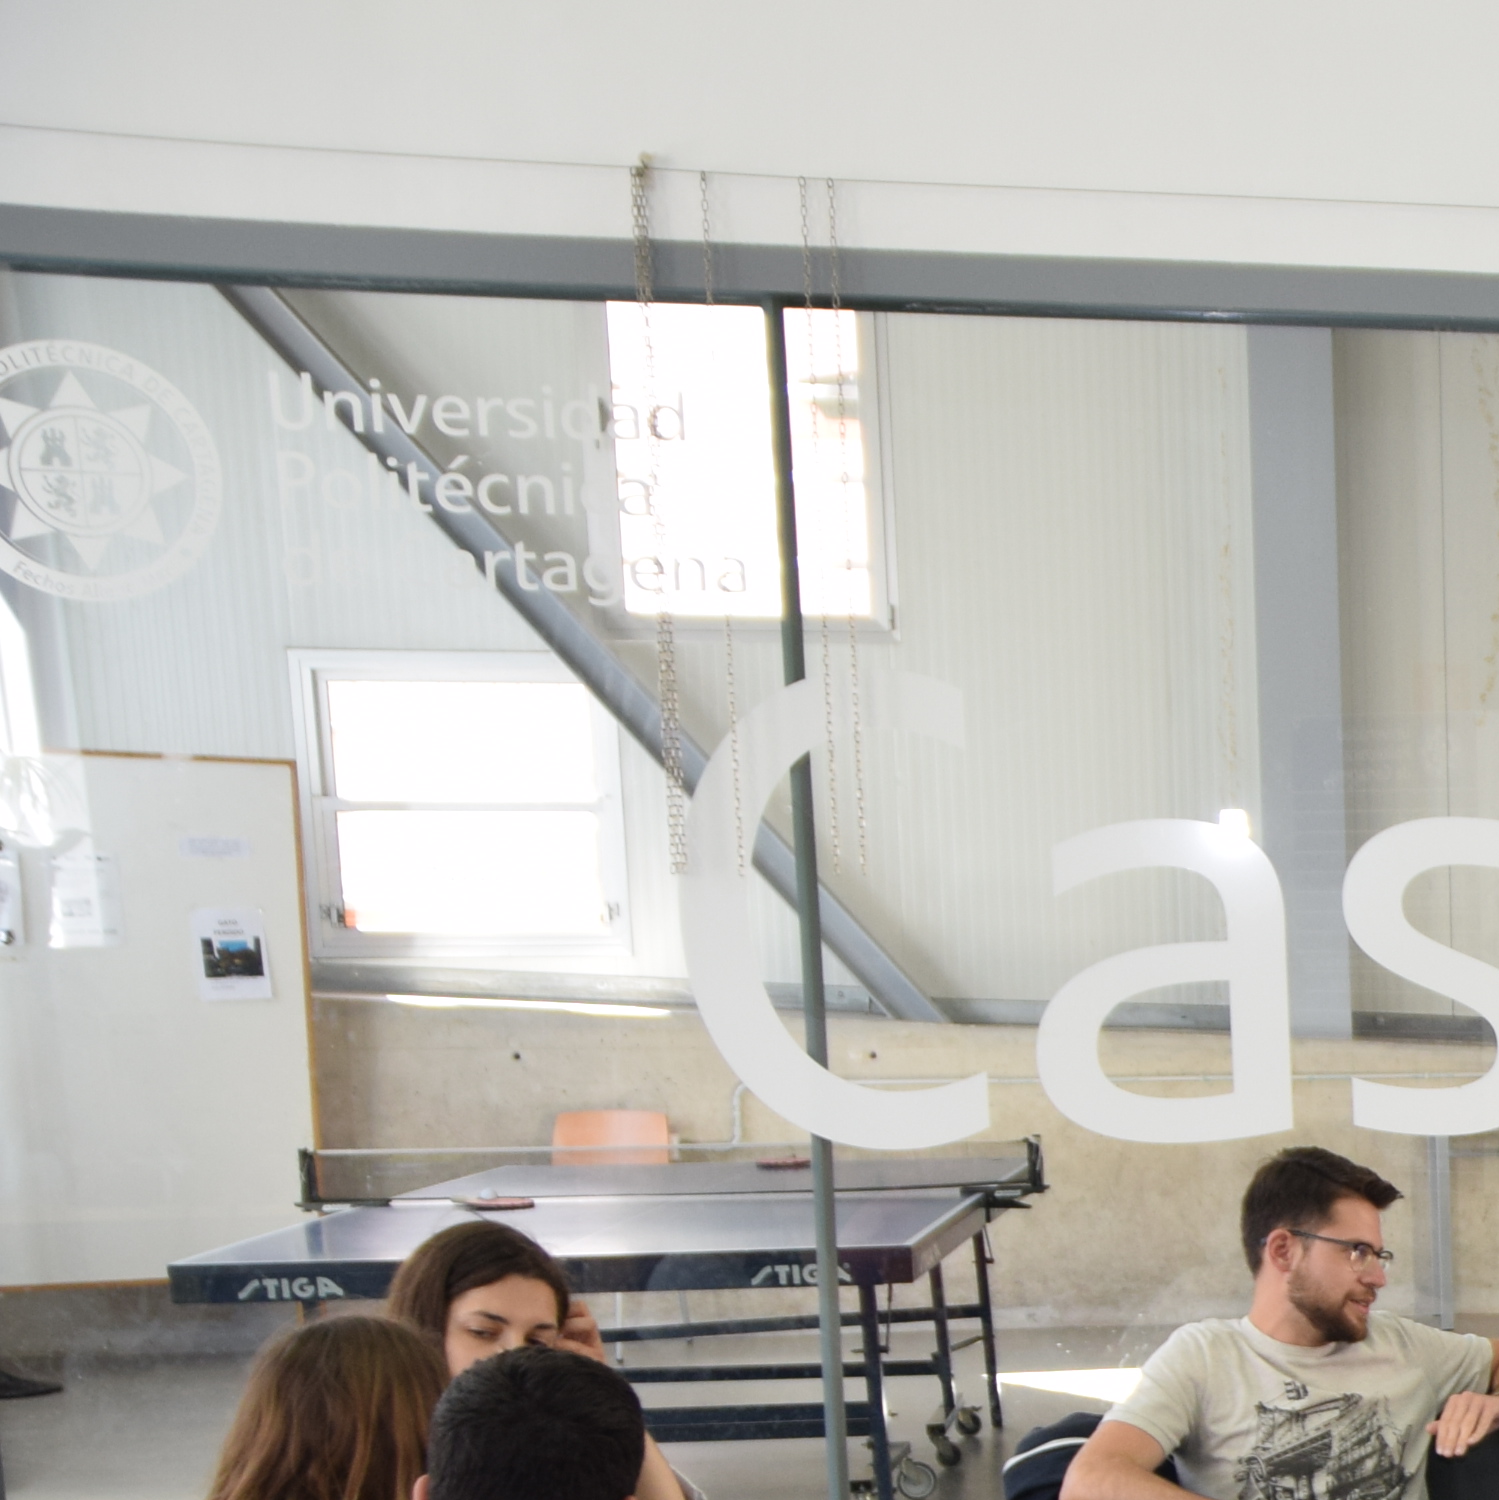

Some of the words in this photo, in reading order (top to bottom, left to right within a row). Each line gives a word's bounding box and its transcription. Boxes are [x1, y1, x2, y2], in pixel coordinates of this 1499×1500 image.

[268, 371, 686, 441] Universidad
[276, 449, 654, 516] Politécnica
[237, 1276, 345, 1301] STIGA
